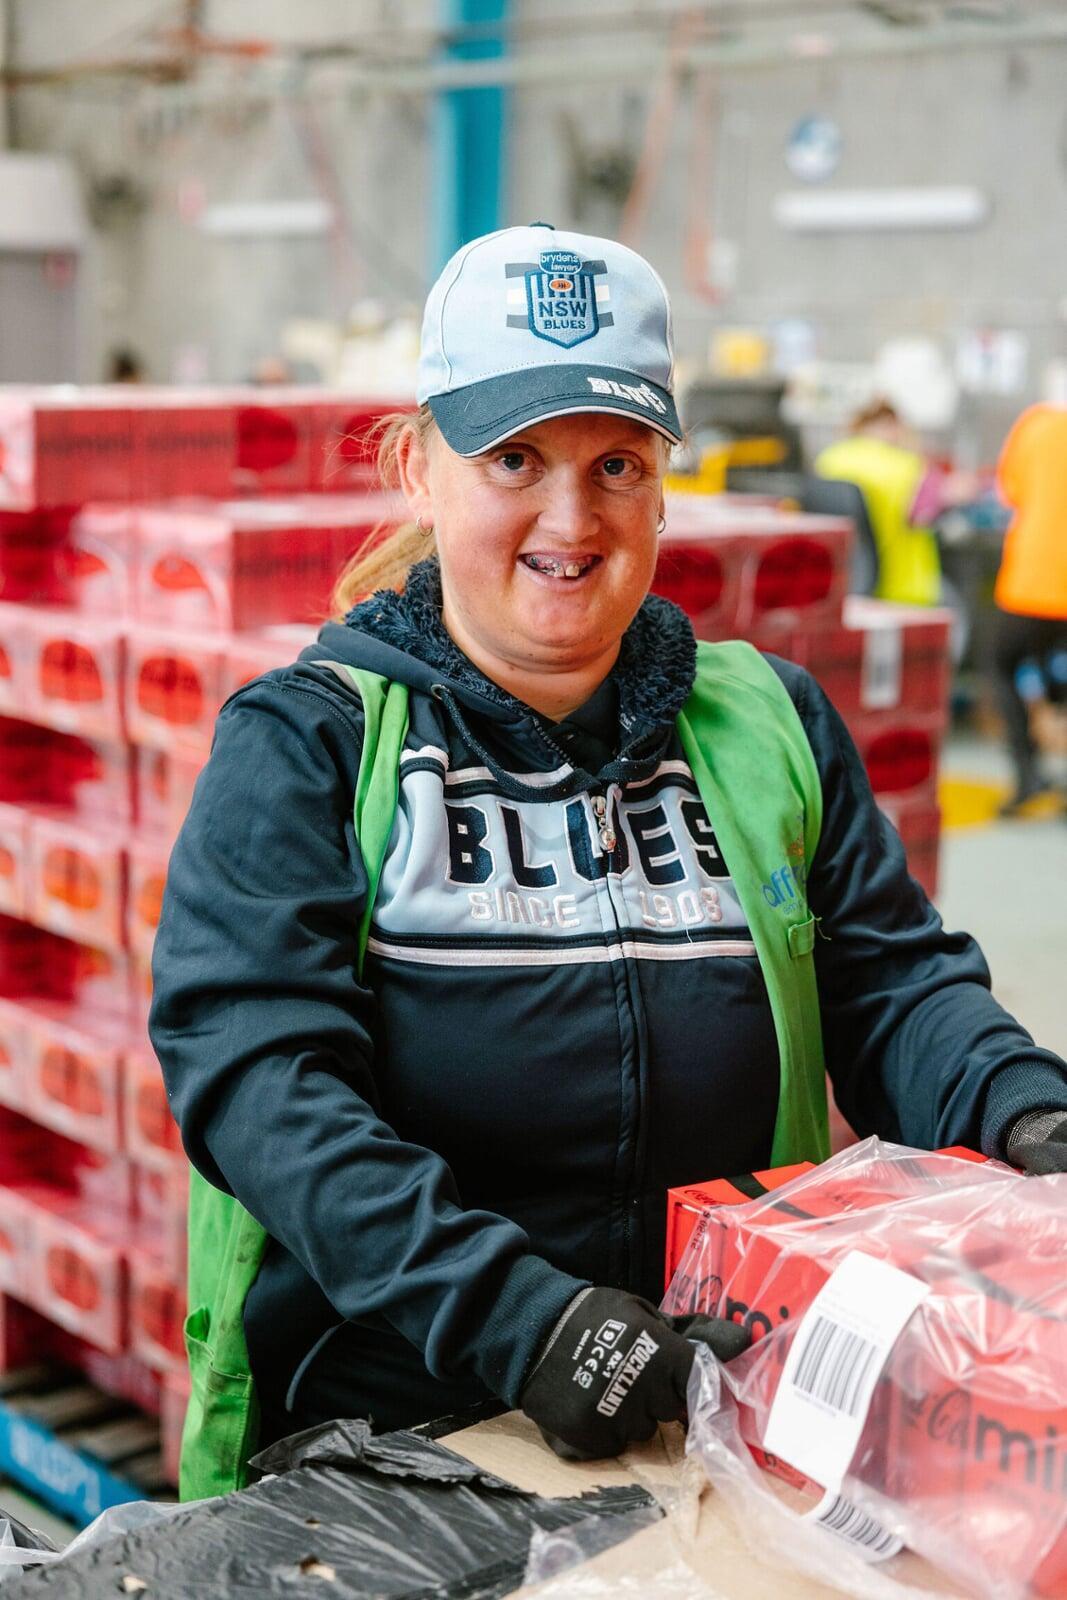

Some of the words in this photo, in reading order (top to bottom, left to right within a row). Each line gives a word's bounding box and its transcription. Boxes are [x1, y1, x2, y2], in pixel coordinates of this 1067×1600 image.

[541, 252, 579, 264] brydens
[538, 301, 587, 318] NSW
[544, 320, 586, 330] BLUES
[444, 794, 732, 890] BLUES
[467, 887, 581, 929] SINCE
[638, 886, 722, 928] 1908
[596, 1329, 660, 1417] ROCKLAND
[602, 1350, 624, 1378] RX-1
[975, 1414, 1067, 1496] mi
